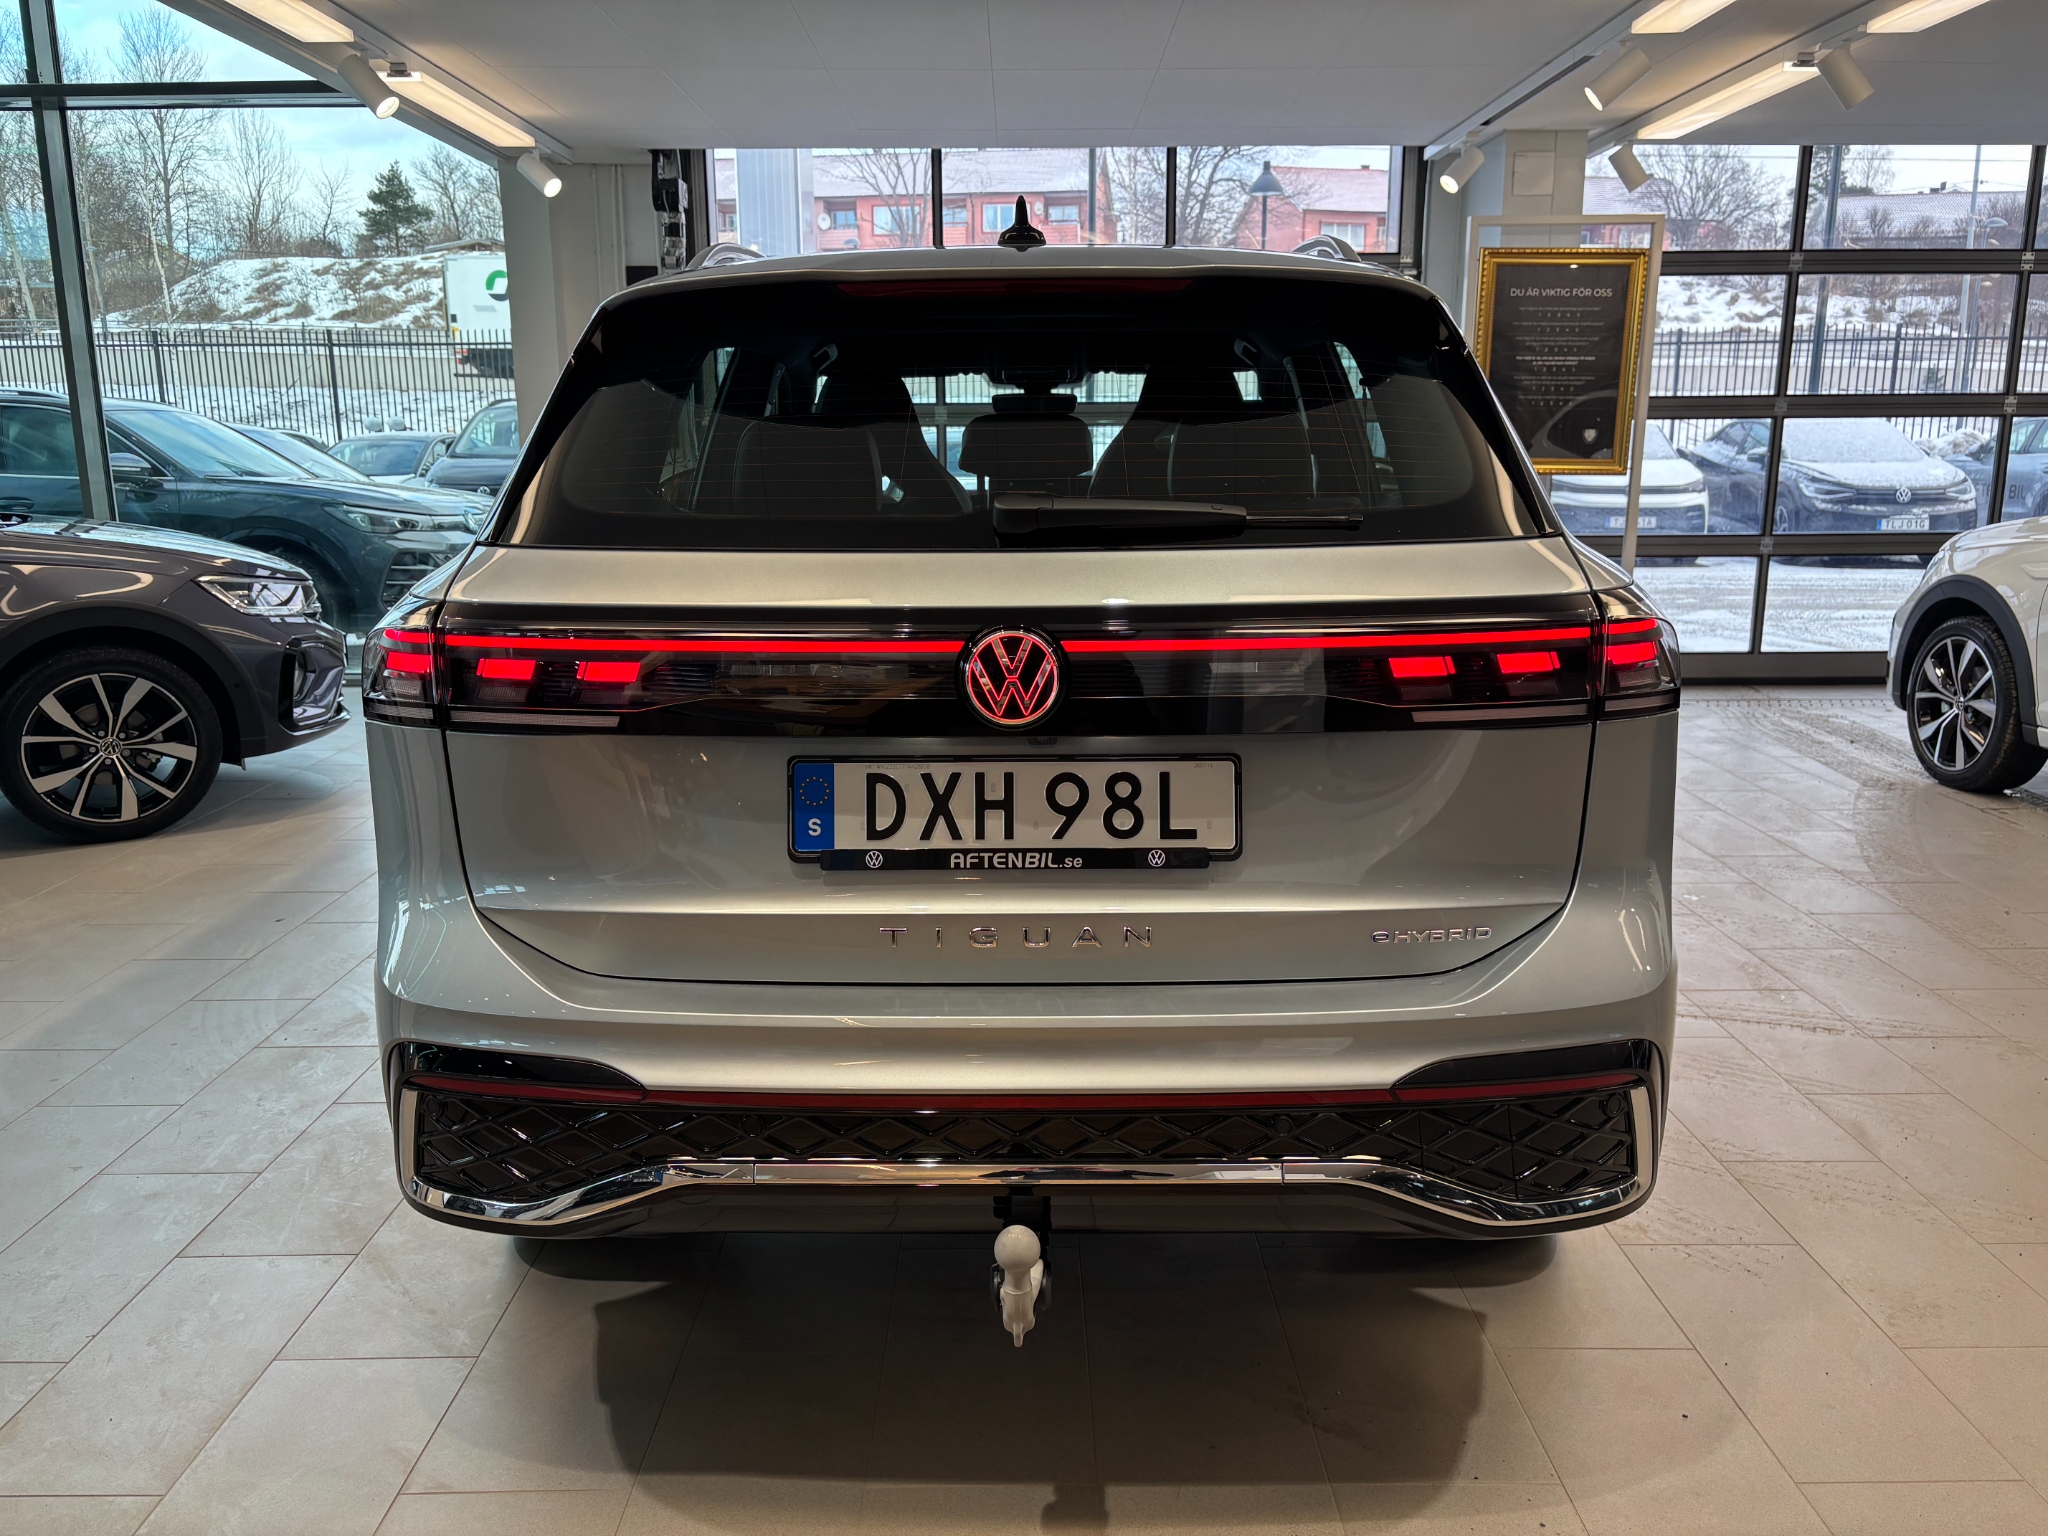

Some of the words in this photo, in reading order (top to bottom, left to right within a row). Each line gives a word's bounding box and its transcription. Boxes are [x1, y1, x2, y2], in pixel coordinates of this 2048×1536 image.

[1510, 287, 1525, 297] DU
[1525, 286, 1540, 297] ÄR
[1541, 287, 1571, 297] VIKTIG
[1572, 286, 1592, 297] FÖR
[1593, 287, 1613, 297] OSS
[1886, 519, 1904, 529] TLJ
[966, 630, 1059, 725] VW
[865, 771, 1015, 841] DXH
[1044, 771, 1198, 840] 98L
[808, 818, 821, 836] S
[865, 850, 883, 869] VW
[950, 852, 1083, 869] AFTENBIL.se
[1148, 849, 1166, 867] VW
[879, 926, 1152, 949] TIGUAN
[1371, 927, 1493, 944] eHYBRID
